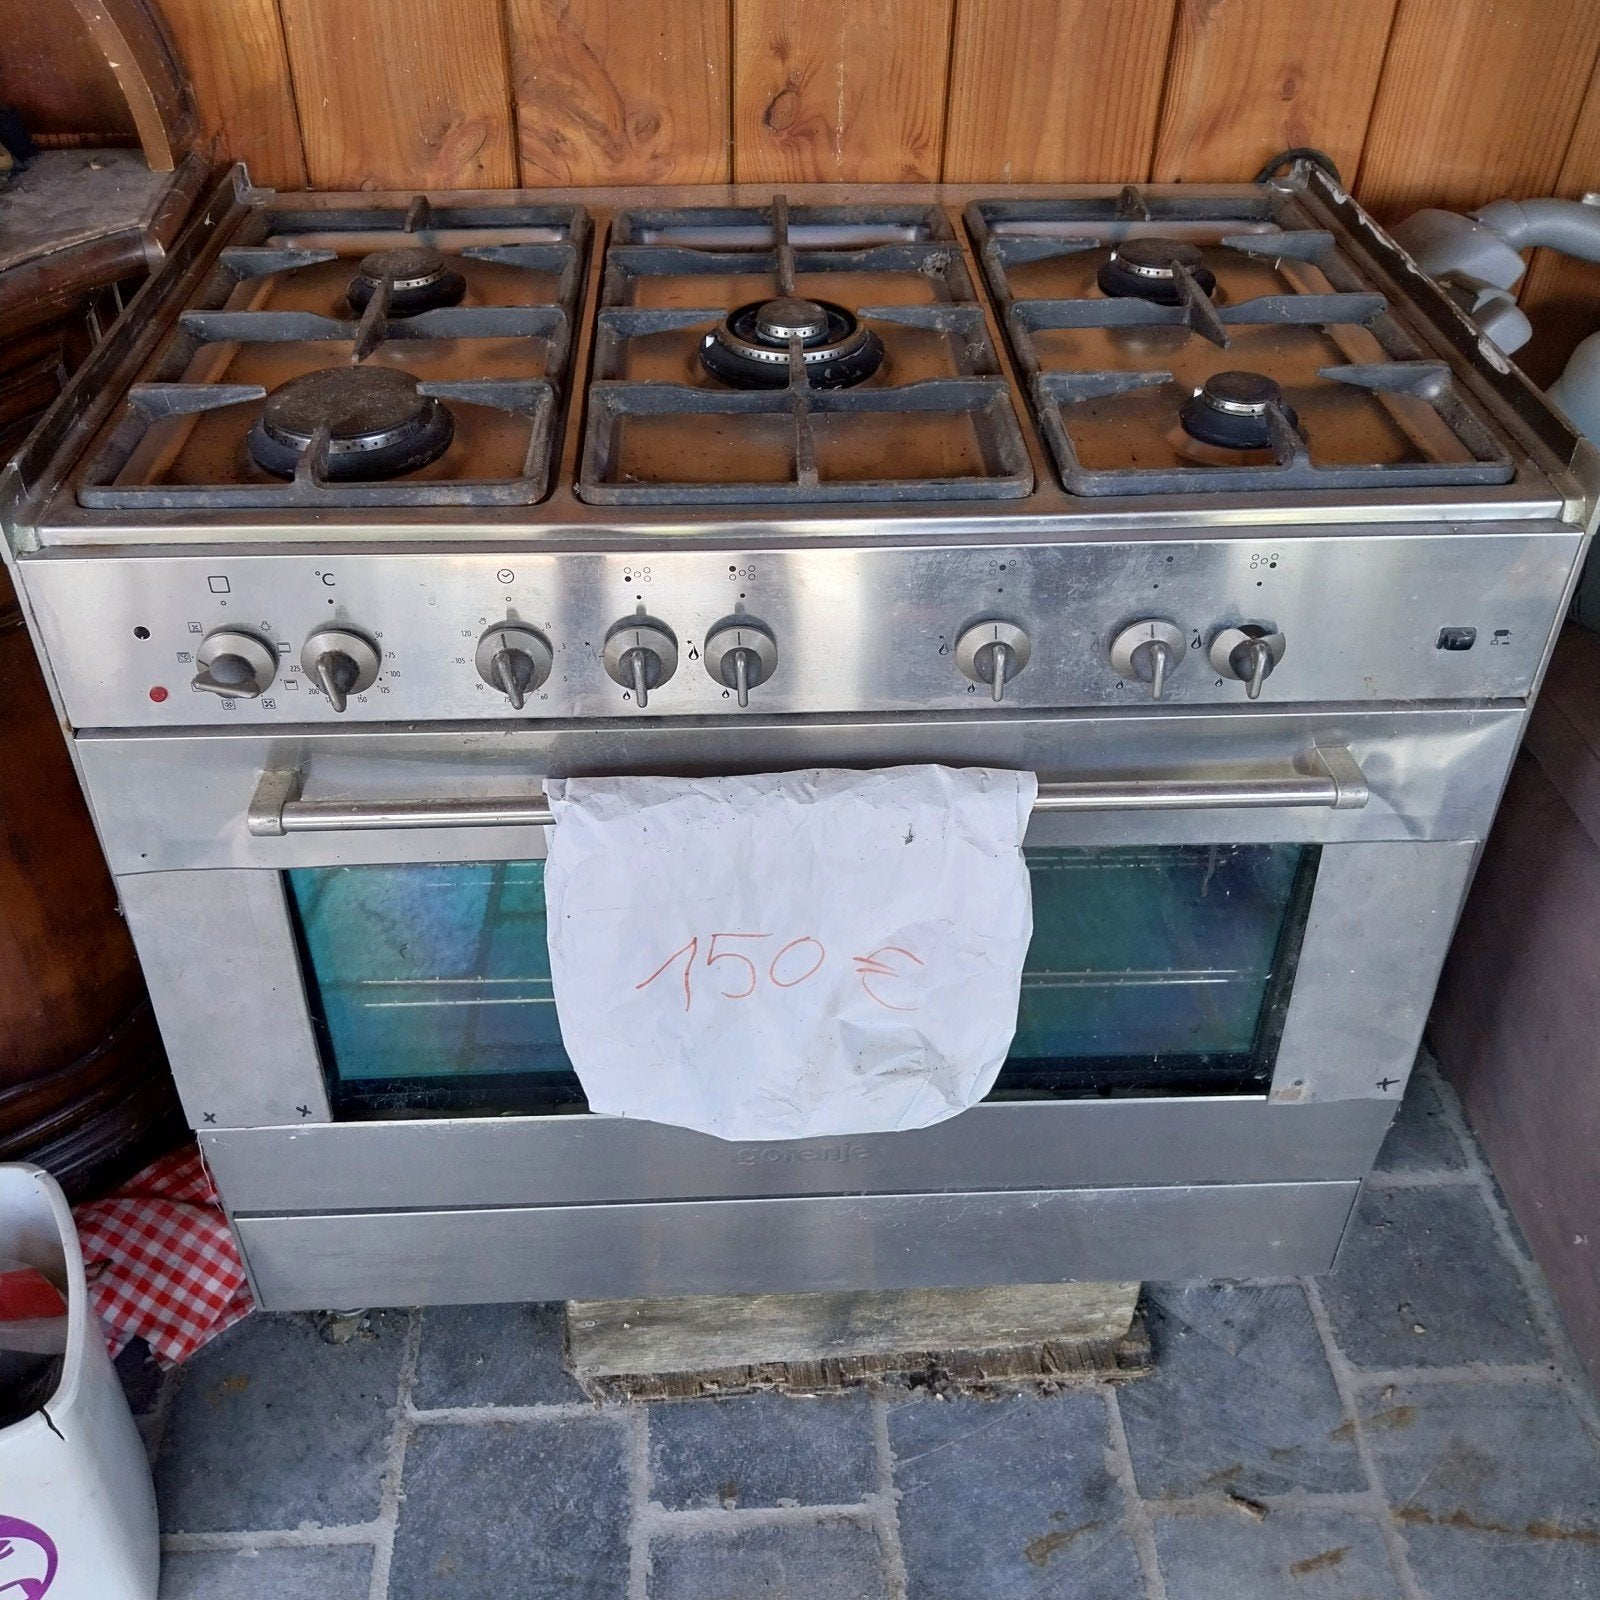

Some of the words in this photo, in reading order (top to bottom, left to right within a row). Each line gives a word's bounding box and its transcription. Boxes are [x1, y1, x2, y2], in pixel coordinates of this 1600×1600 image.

[461, 629, 472, 637] 120
[390, 670, 401, 678] 100
[380, 686, 390, 694] 125
[475, 683, 484, 691] 90
[635, 932, 825, 1012] 150
[852, 946, 925, 1011] €
[737, 1141, 871, 1166] gorenje
